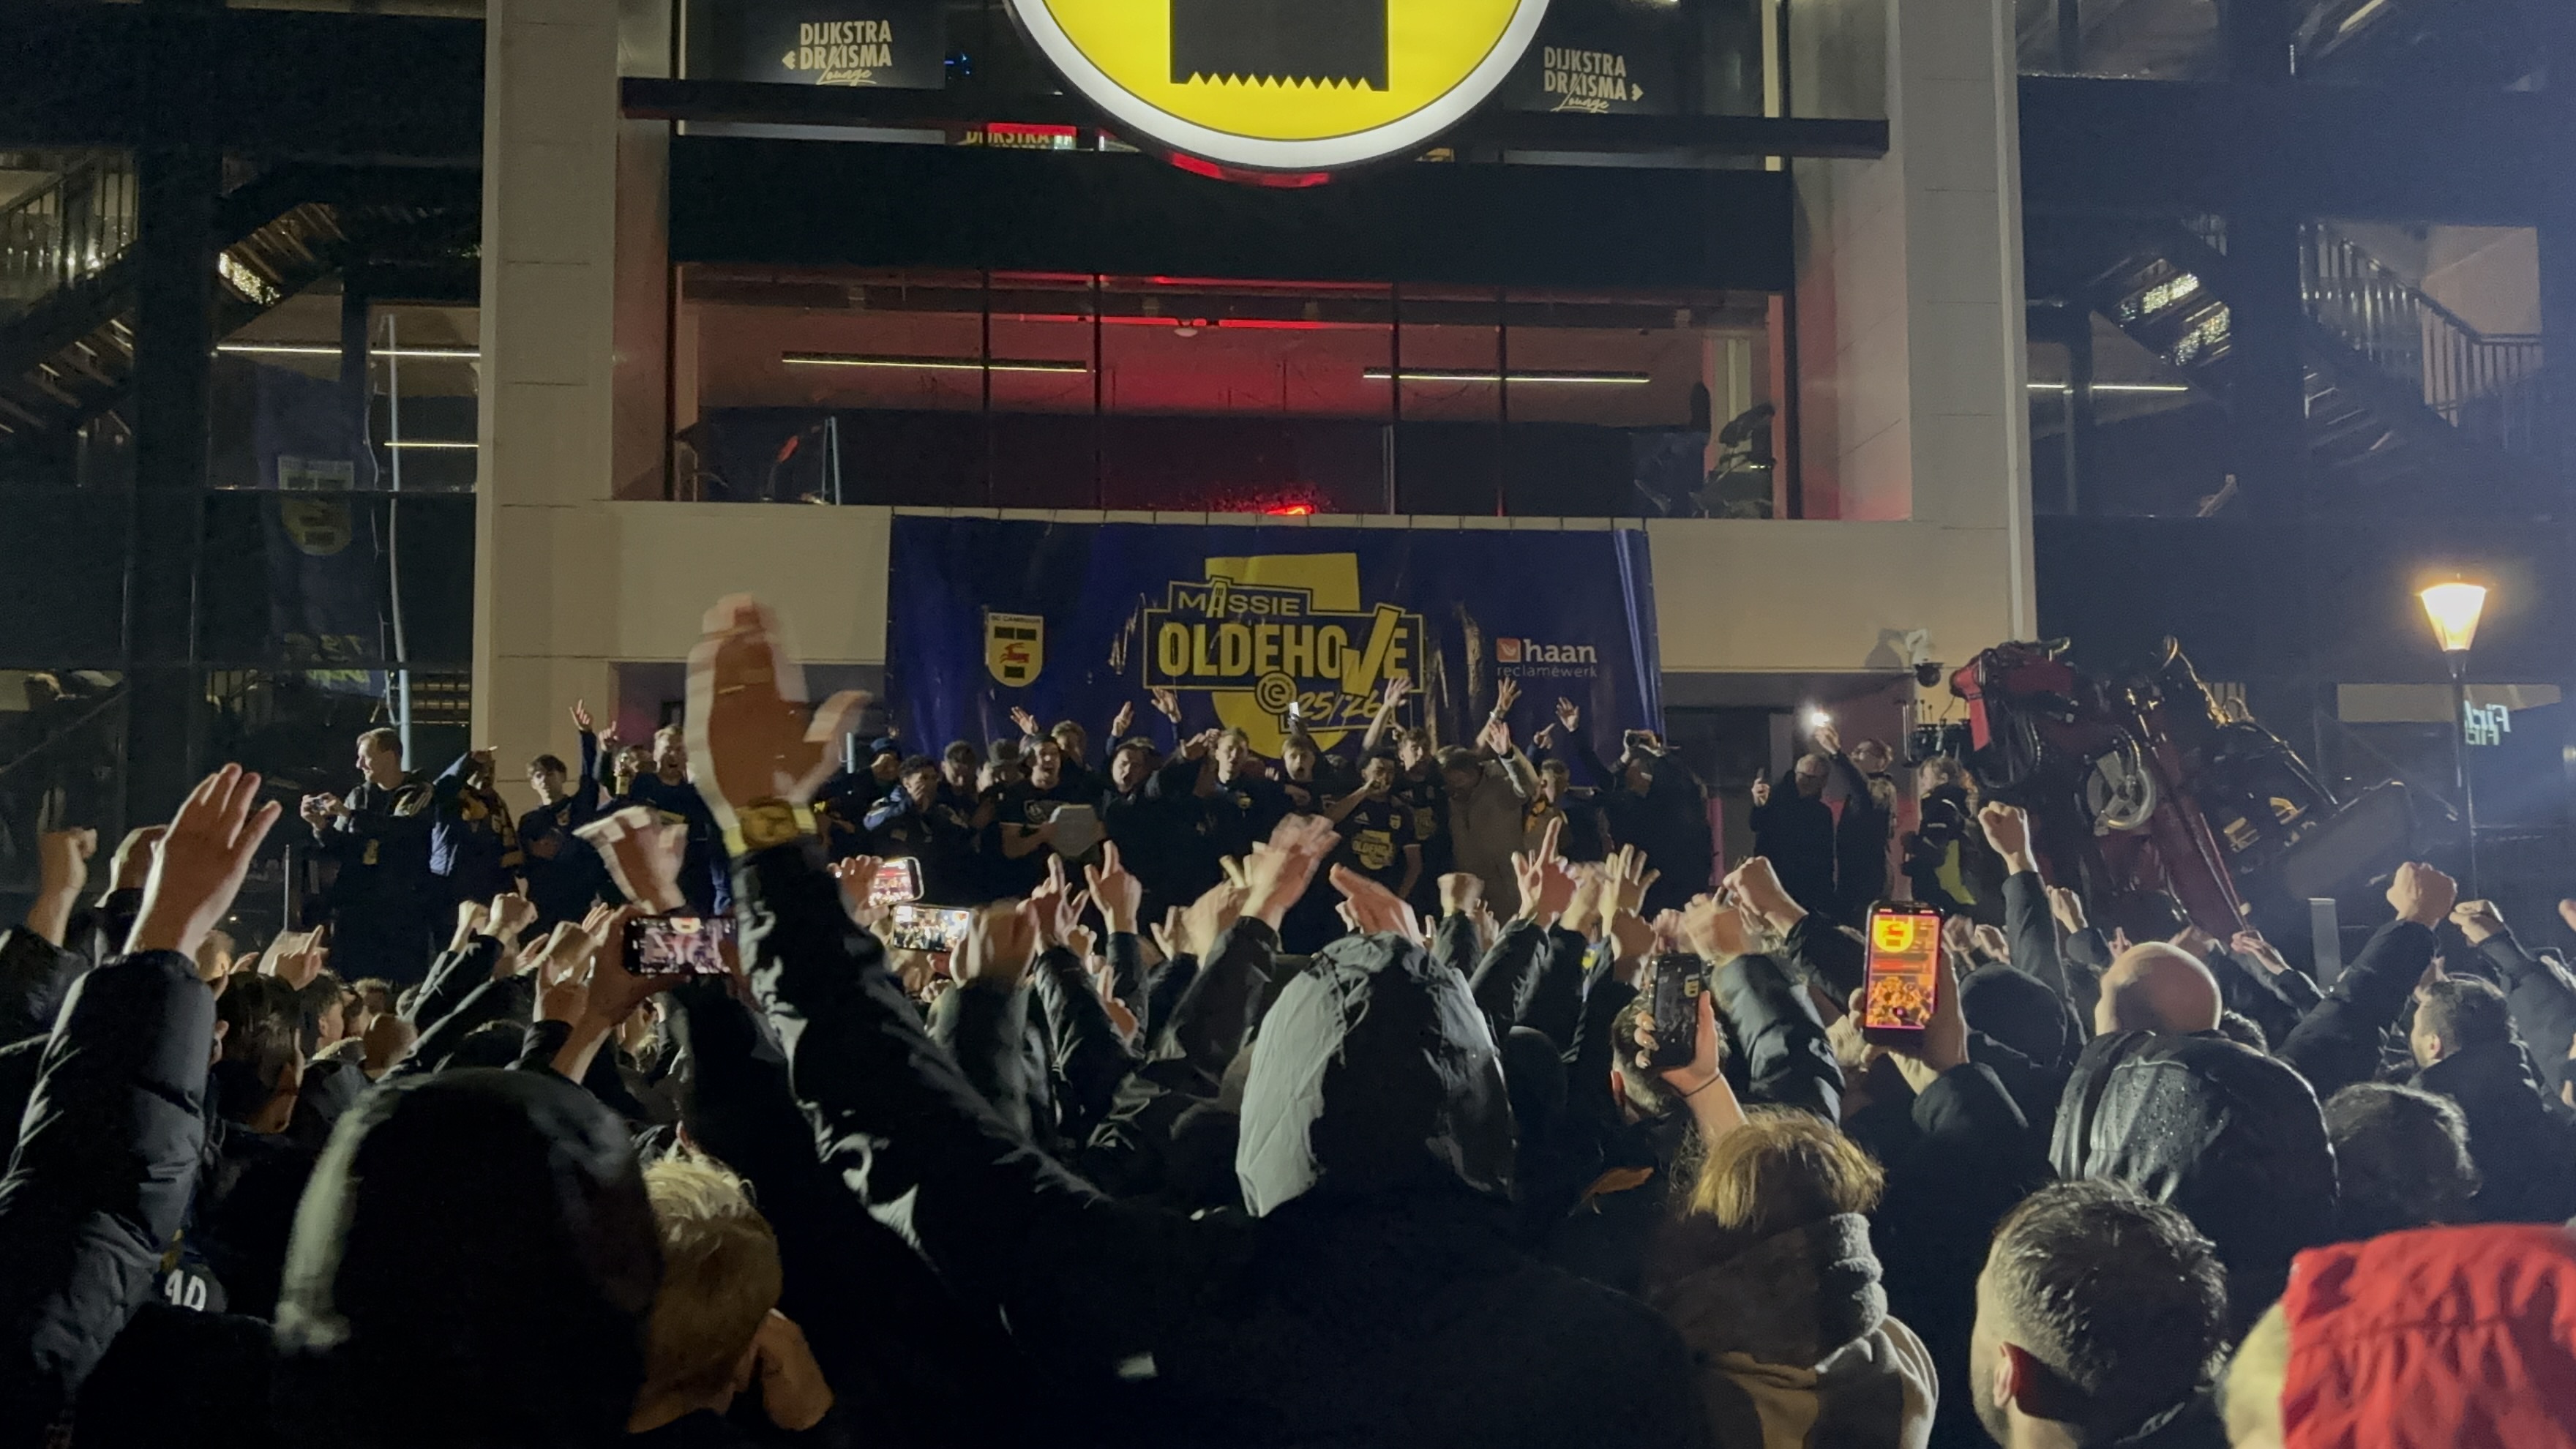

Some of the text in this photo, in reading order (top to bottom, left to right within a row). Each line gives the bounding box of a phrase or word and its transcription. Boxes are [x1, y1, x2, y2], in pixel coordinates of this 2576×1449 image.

[800, 20, 892, 45] DIJKSTRA
[800, 44, 892, 70] DRAISMA
[1544, 46, 1626, 77] DIJKSTRA
[1544, 70, 1628, 101] DRAISMA
[1177, 582, 1300, 618] MASSIE
[1158, 605, 1409, 697] OLDEHOVE
[1524, 638, 1598, 663] haan
[1497, 665, 1598, 678] reclamewerk
[1297, 689, 1383, 726] 25/26
